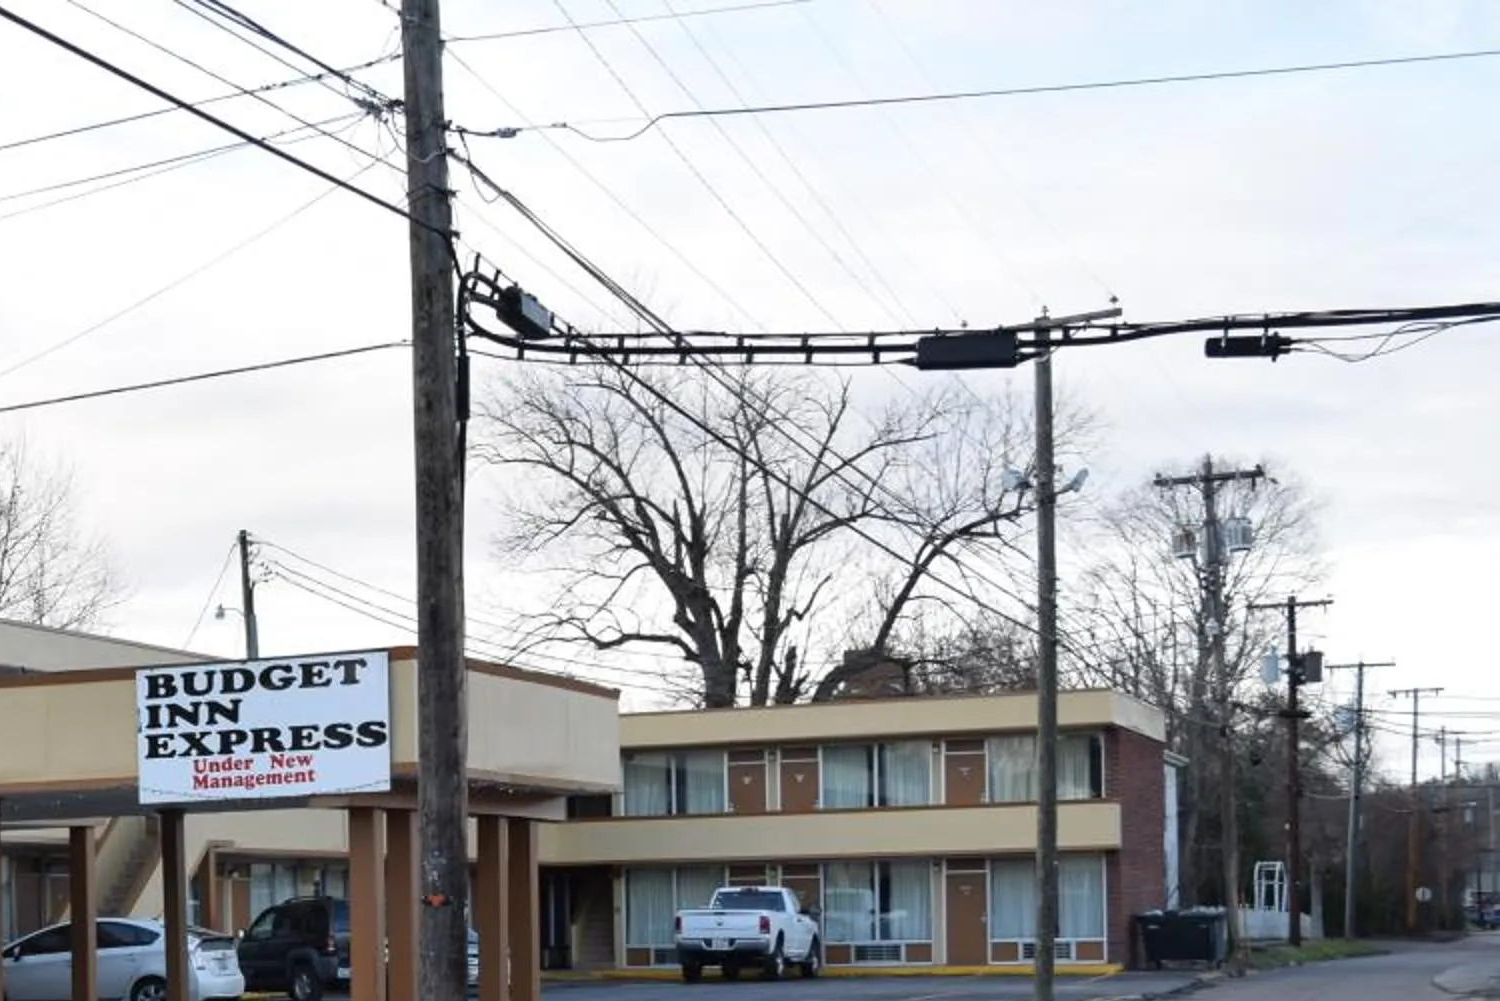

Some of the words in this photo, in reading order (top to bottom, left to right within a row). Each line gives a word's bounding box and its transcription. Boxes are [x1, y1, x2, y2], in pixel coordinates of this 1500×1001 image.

[145, 658, 367, 700] BUDGET
[145, 699, 243, 729] INN
[144, 721, 387, 760] EXPRESS
[193, 756, 254, 774] Under
[269, 753, 314, 769] New
[192, 769, 316, 790] Management
